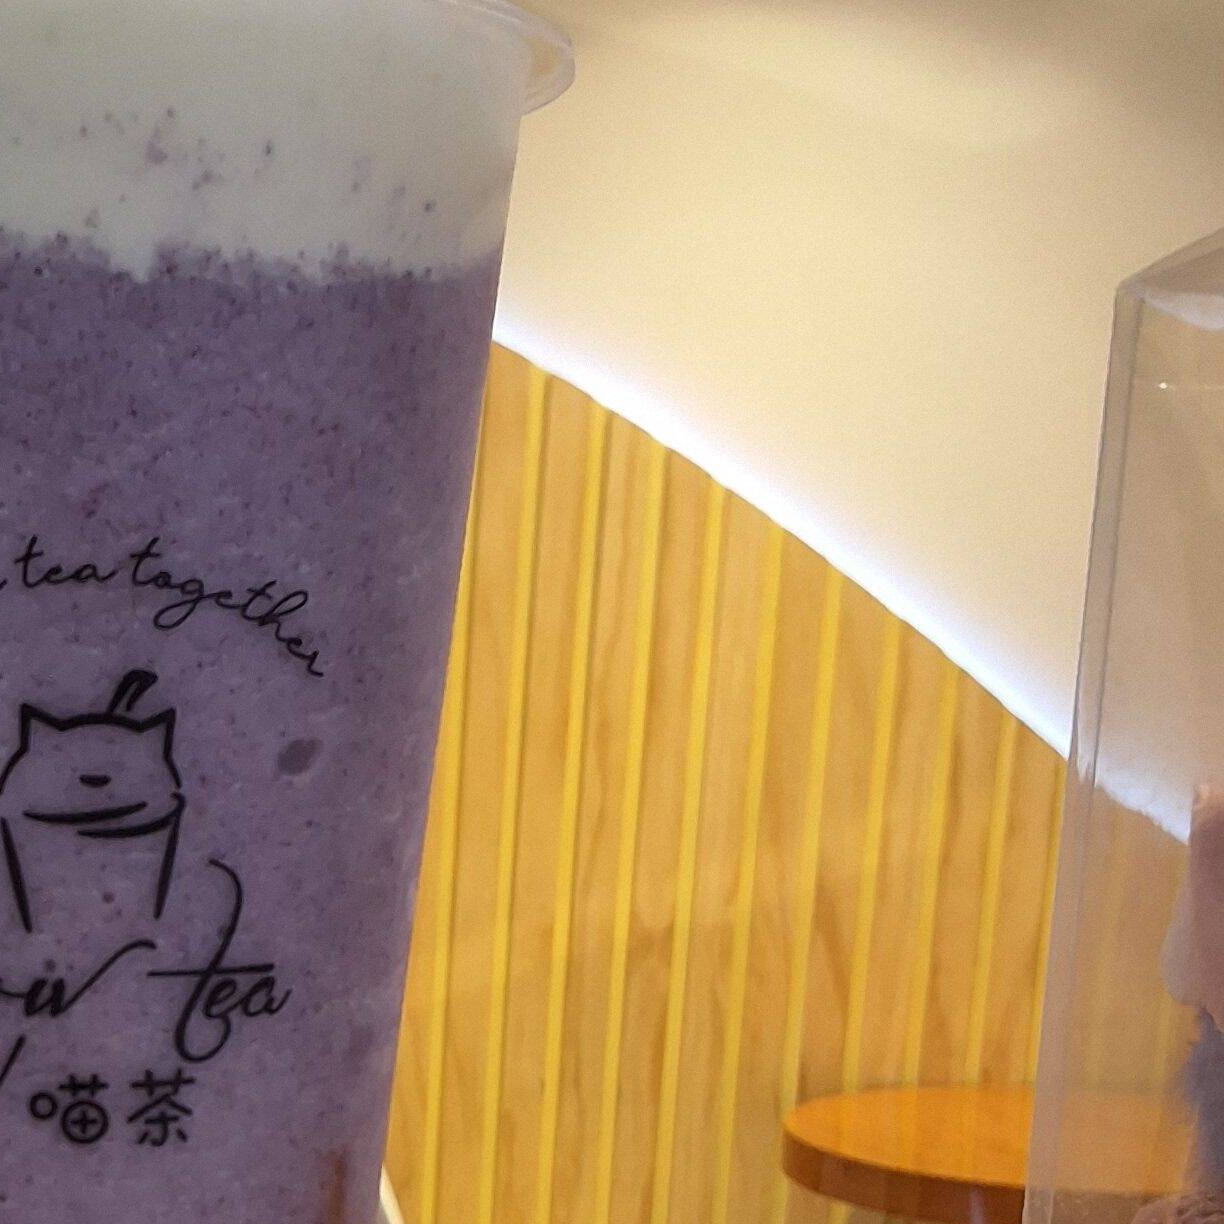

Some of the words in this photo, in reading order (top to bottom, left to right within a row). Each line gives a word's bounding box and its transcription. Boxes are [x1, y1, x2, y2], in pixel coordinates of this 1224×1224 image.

[14, 534, 116, 588] tea
[130, 537, 324, 677] together
[148, 858, 291, 1062] tea
[29, 1069, 196, 1147] 喵茶
